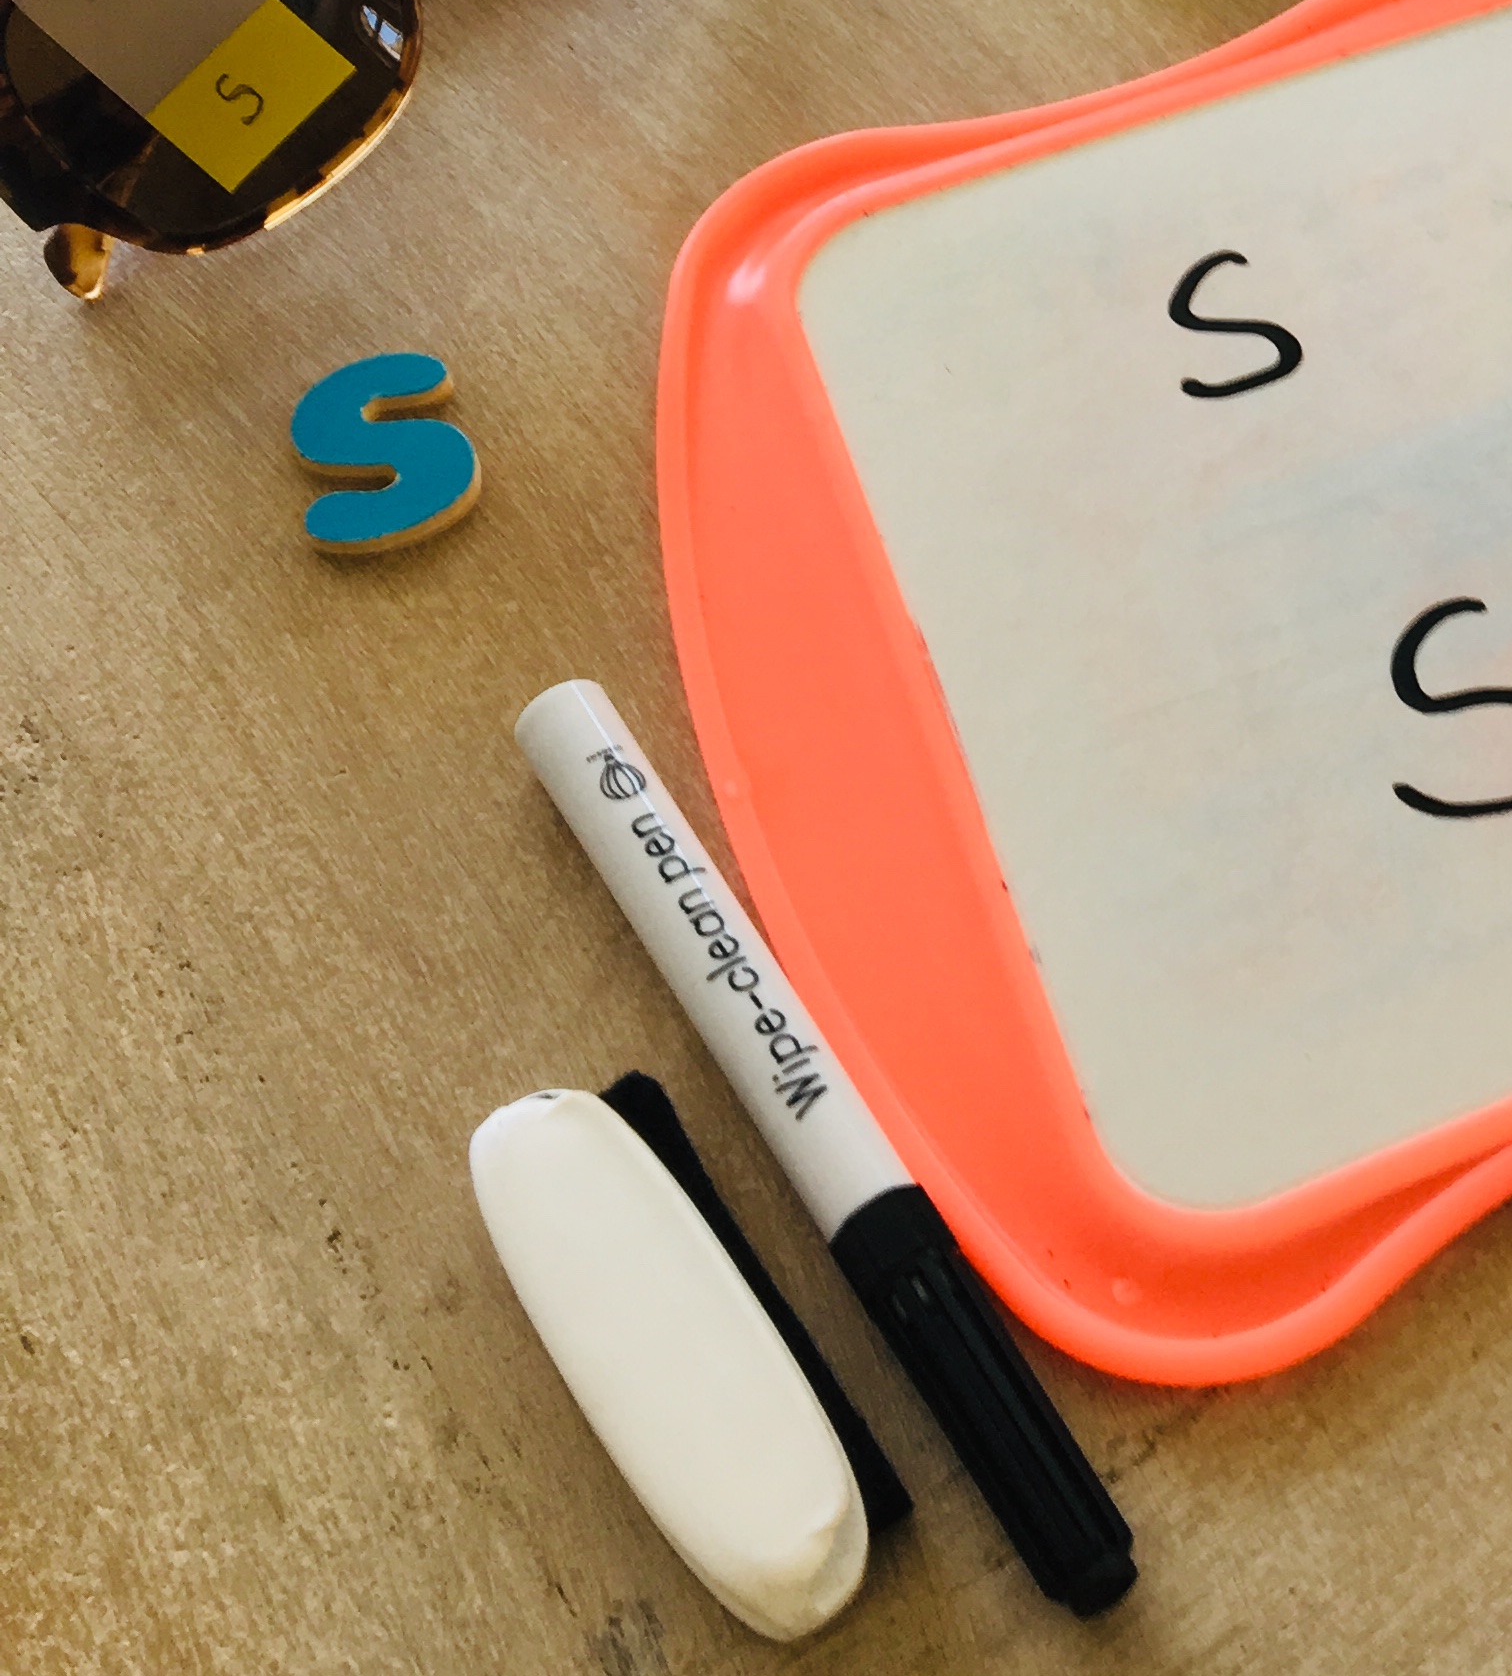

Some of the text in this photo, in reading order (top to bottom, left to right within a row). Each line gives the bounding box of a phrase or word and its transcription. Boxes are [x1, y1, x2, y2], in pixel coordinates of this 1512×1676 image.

[214, 73, 265, 127] S
[1168, 250, 1303, 399] S
[290, 352, 480, 546] S
[631, 812, 828, 1121] Wipe-clean pen
